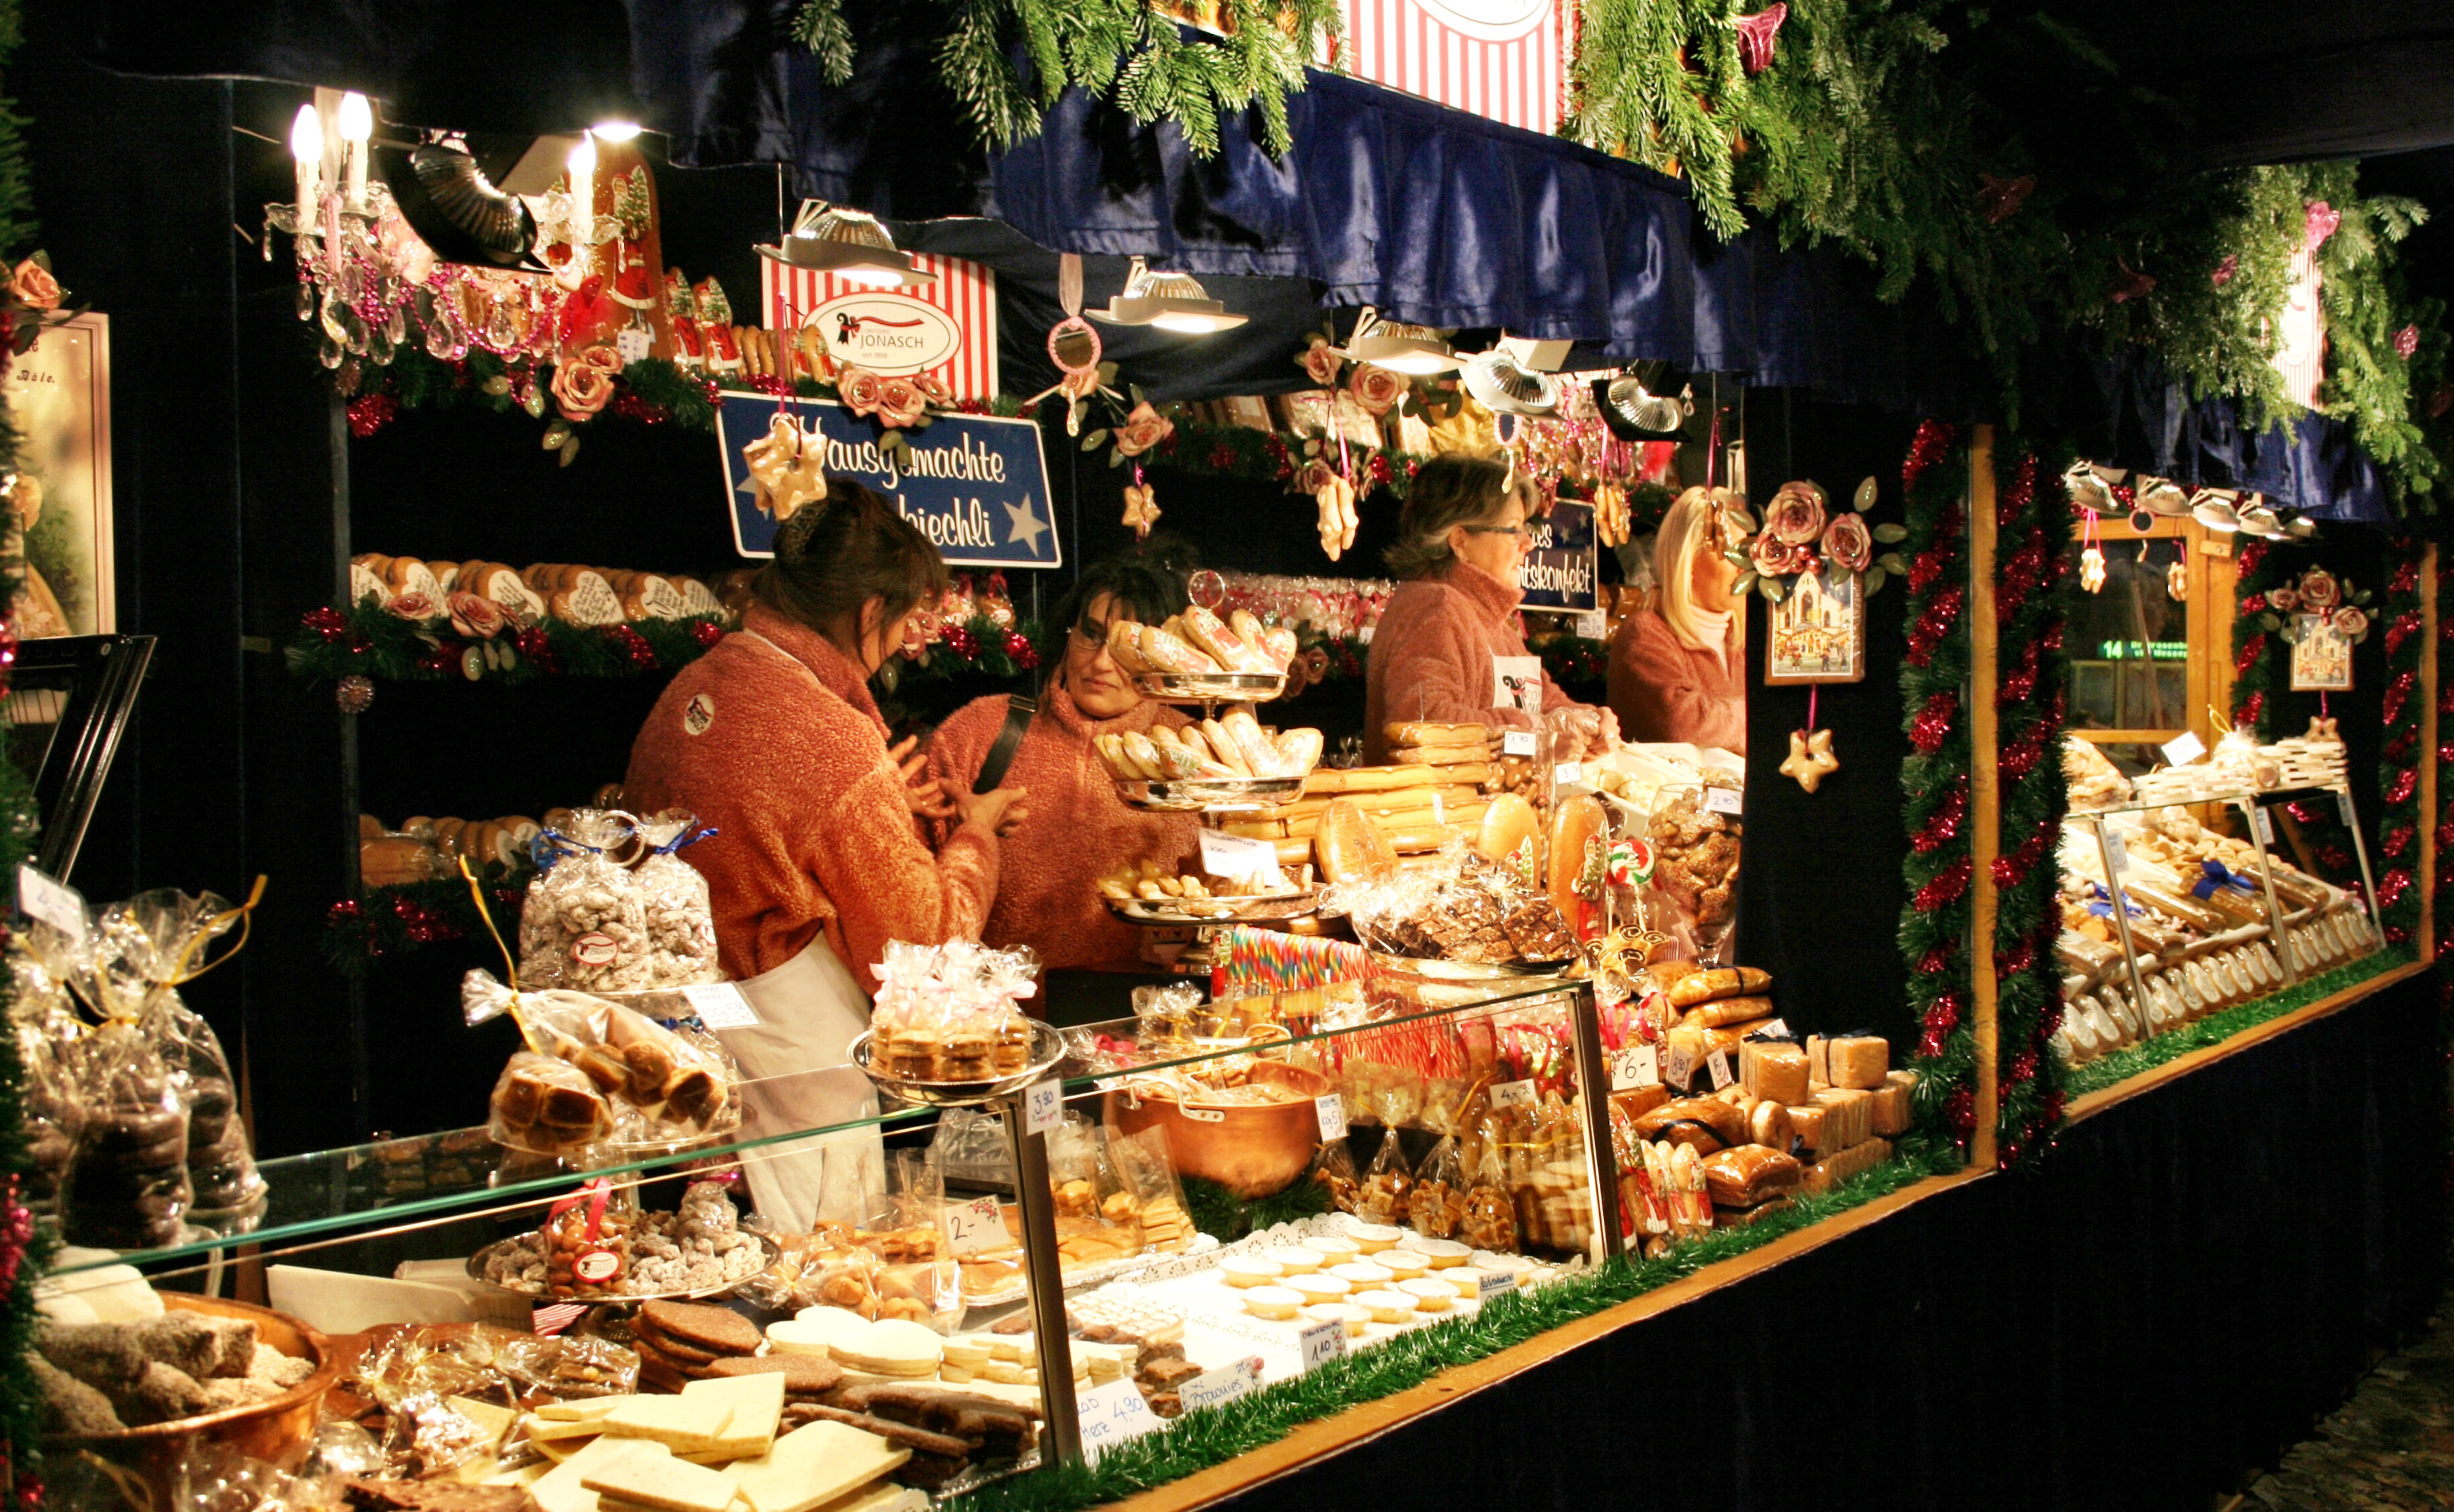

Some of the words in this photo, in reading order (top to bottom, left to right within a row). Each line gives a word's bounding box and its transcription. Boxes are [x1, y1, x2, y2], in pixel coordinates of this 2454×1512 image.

[859, 334, 924, 349] JONASCH
[770, 412, 1006, 489] ausgmachte
[2103, 640, 2123, 659] 14
[1189, 1379, 1243, 1407] Brownies
